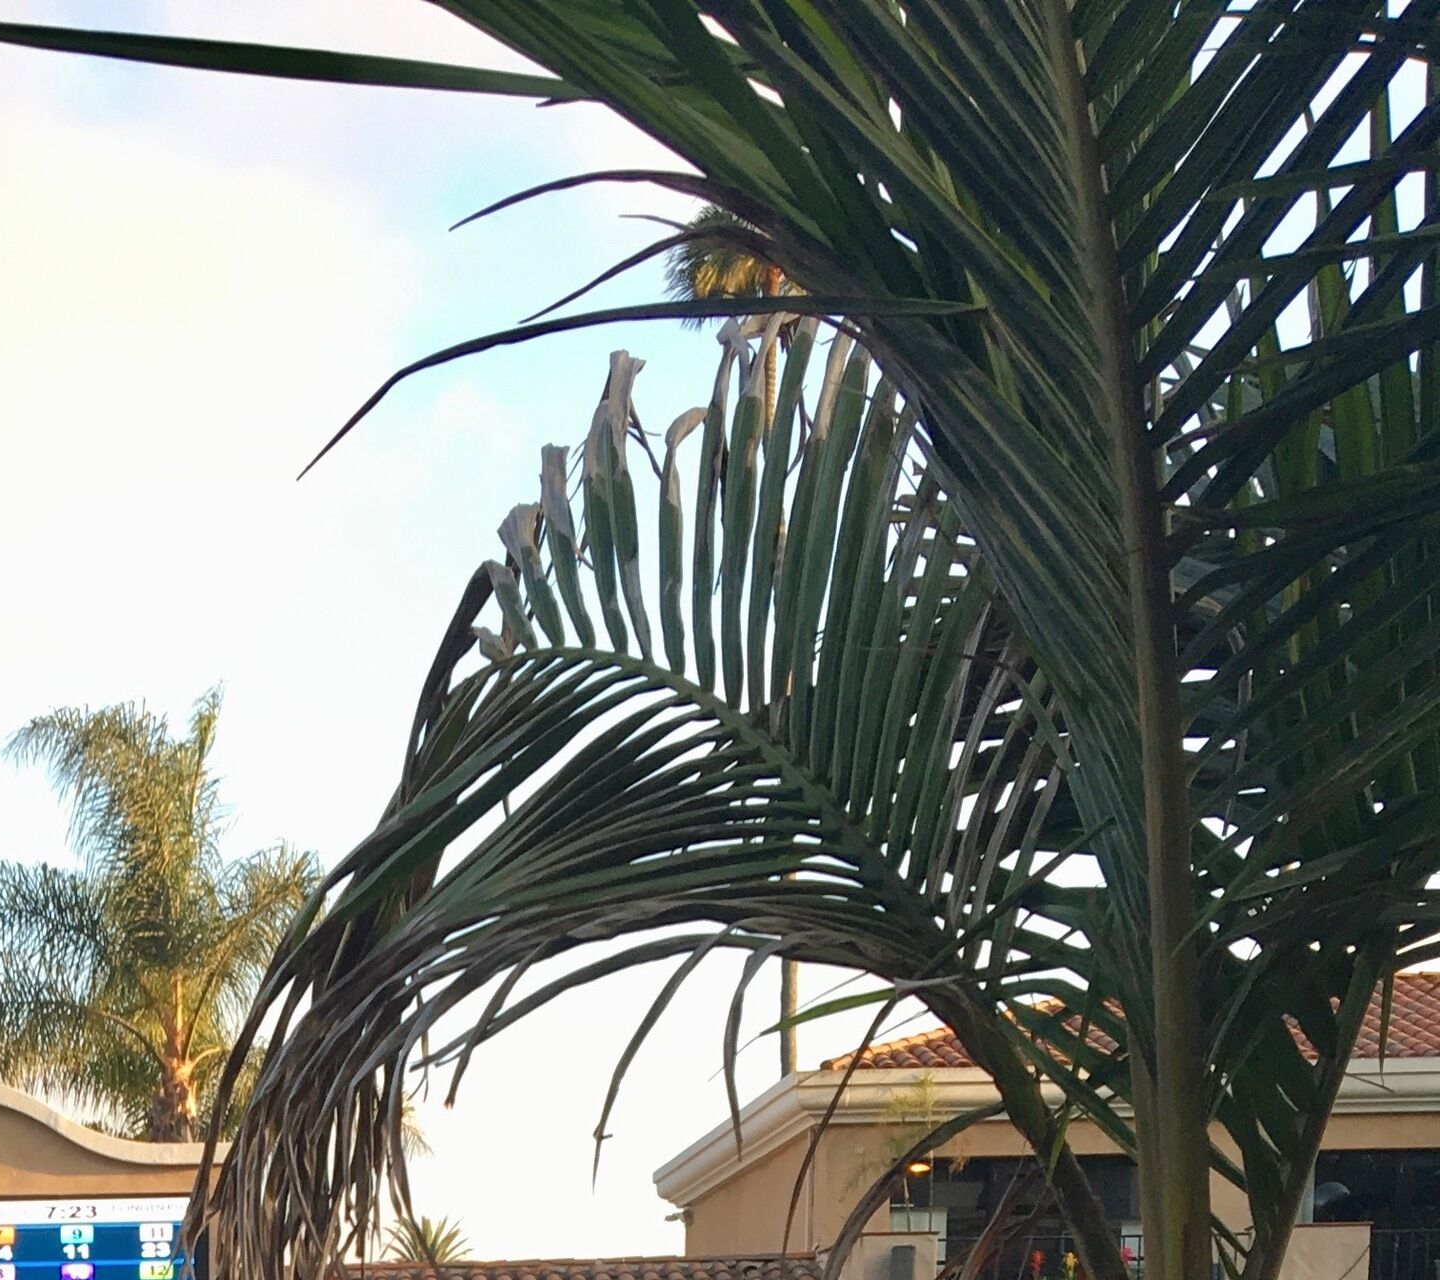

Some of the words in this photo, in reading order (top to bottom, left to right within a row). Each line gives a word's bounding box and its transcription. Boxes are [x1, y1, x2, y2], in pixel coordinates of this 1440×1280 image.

[47, 1205, 97, 1219] 7:23
[72, 1229, 82, 1239] 9
[151, 1228, 165, 1238] 11
[63, 1244, 89, 1259] 11
[141, 1242, 171, 1258] 23
[150, 1265, 166, 1275] 12
